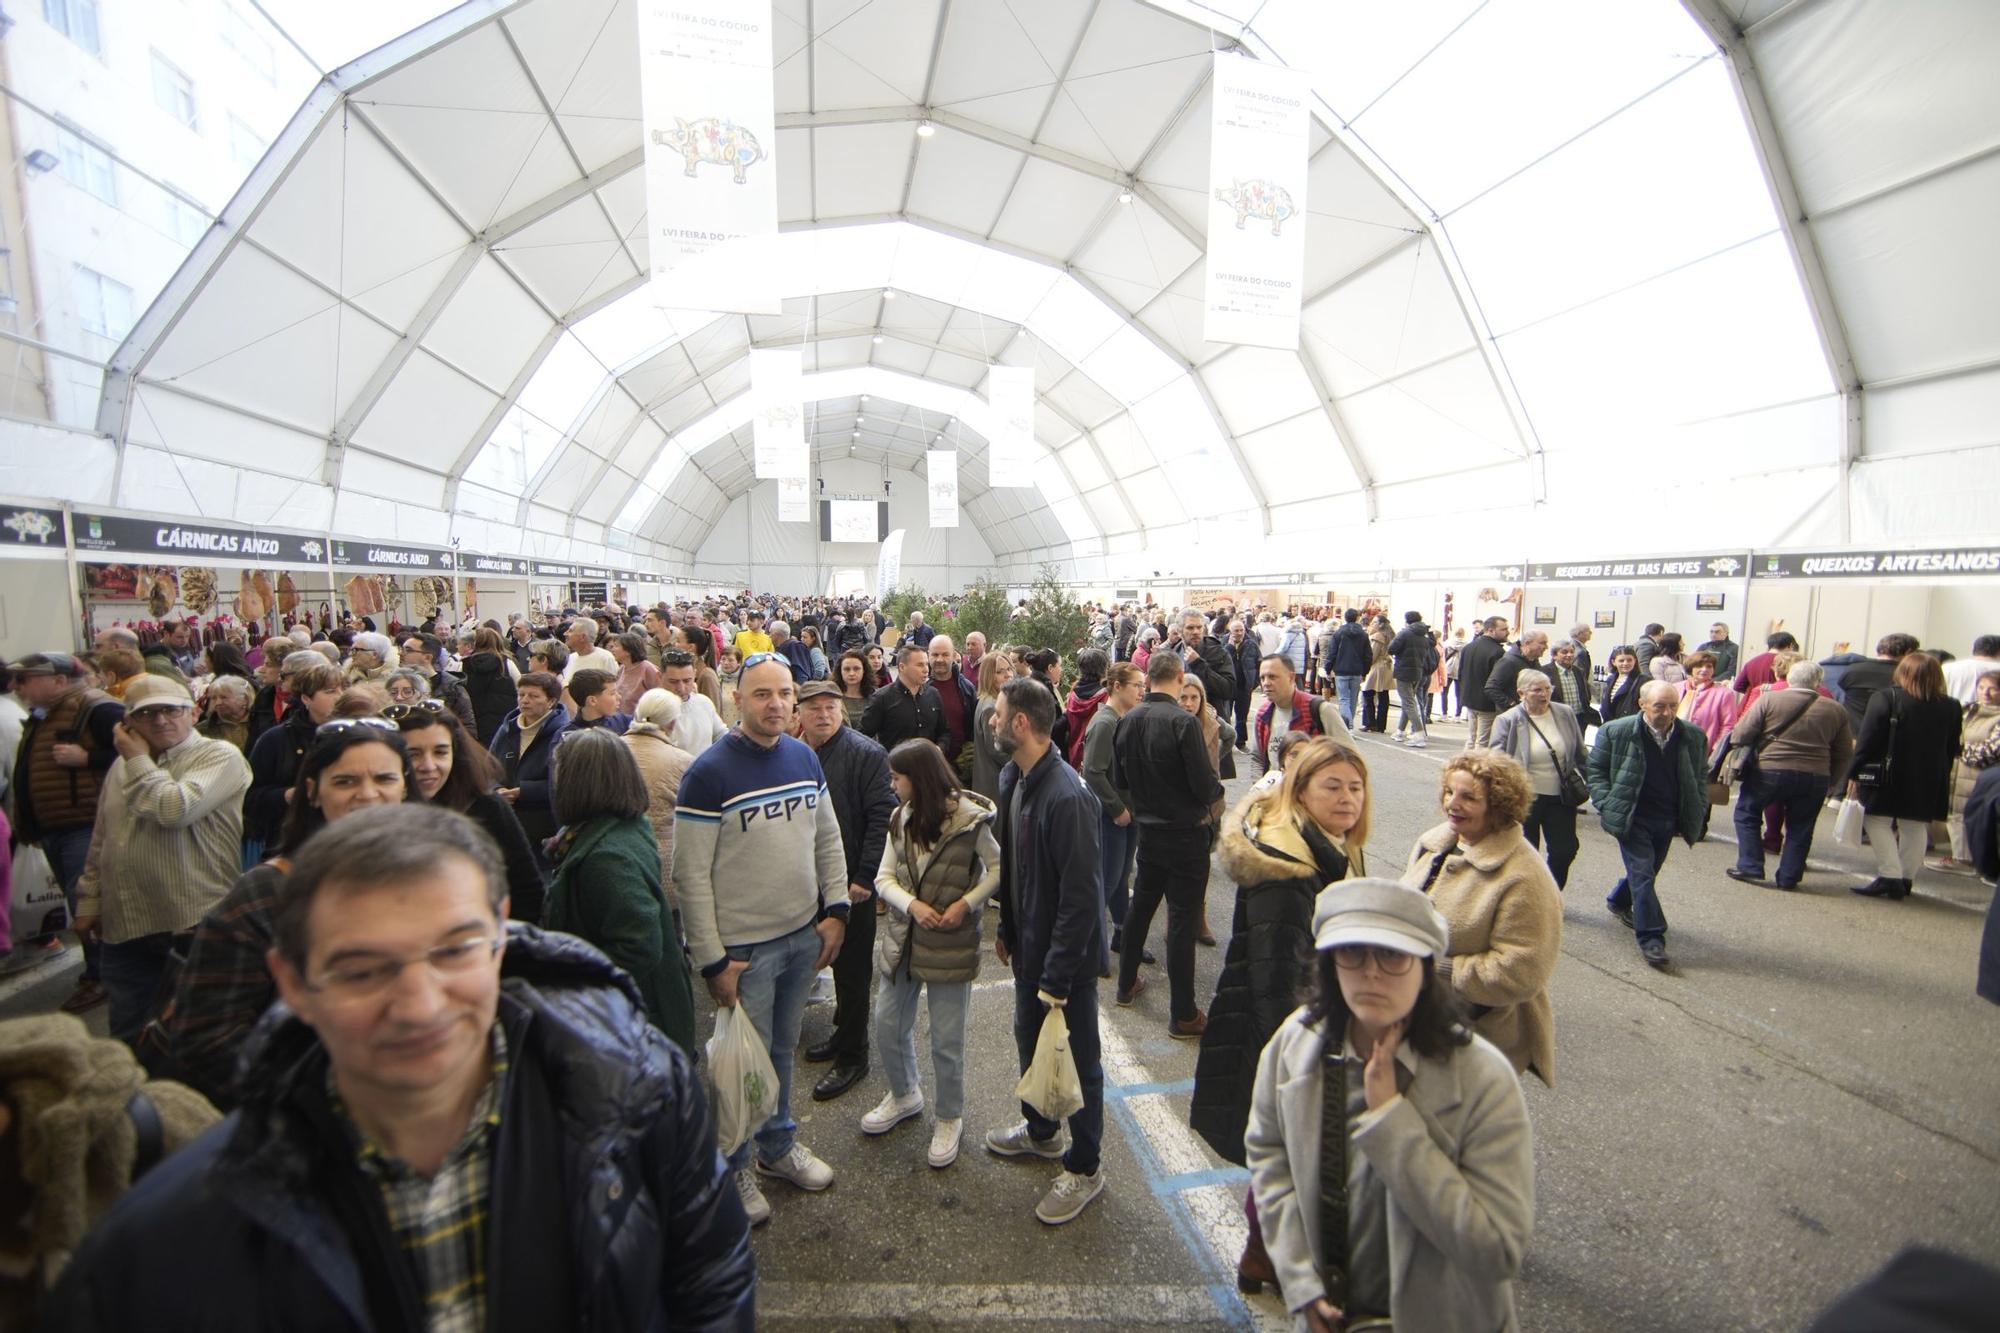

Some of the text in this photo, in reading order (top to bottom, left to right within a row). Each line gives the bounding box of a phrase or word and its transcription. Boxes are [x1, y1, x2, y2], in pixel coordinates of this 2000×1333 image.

[701, 16, 717, 27] DO
[719, 19, 760, 33] COCIDO
[1271, 95, 1301, 108] COCIDO
[680, 230, 708, 240] FEIRA
[709, 232, 726, 241] DO
[1250, 276, 1262, 285] DO
[1262, 278, 1292, 289] COCIDO
[156, 528, 280, 555] CÁRNICAS ANZO
[368, 548, 408, 565] CÁRNICAS
[409, 552, 430, 566] ANZO
[1801, 552, 2000, 574] QUEIXOS ARTESANOS
[1602, 565, 1611, 576] E
[1612, 564, 1635, 576] MEL
[1636, 563, 1660, 575] DAS
[1662, 561, 1702, 575] NEVES
